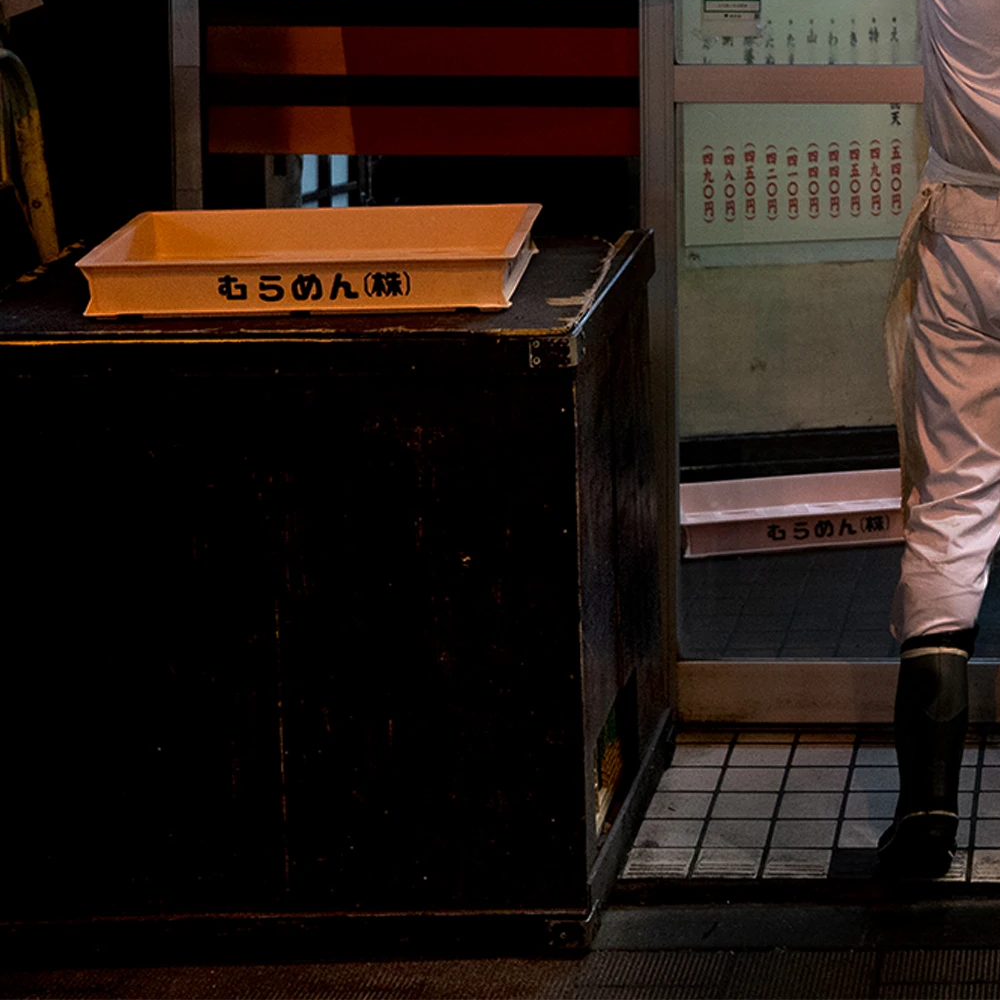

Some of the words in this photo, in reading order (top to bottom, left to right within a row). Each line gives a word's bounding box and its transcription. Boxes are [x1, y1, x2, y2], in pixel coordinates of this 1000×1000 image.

[217, 271, 411, 302] むらめん(株)
